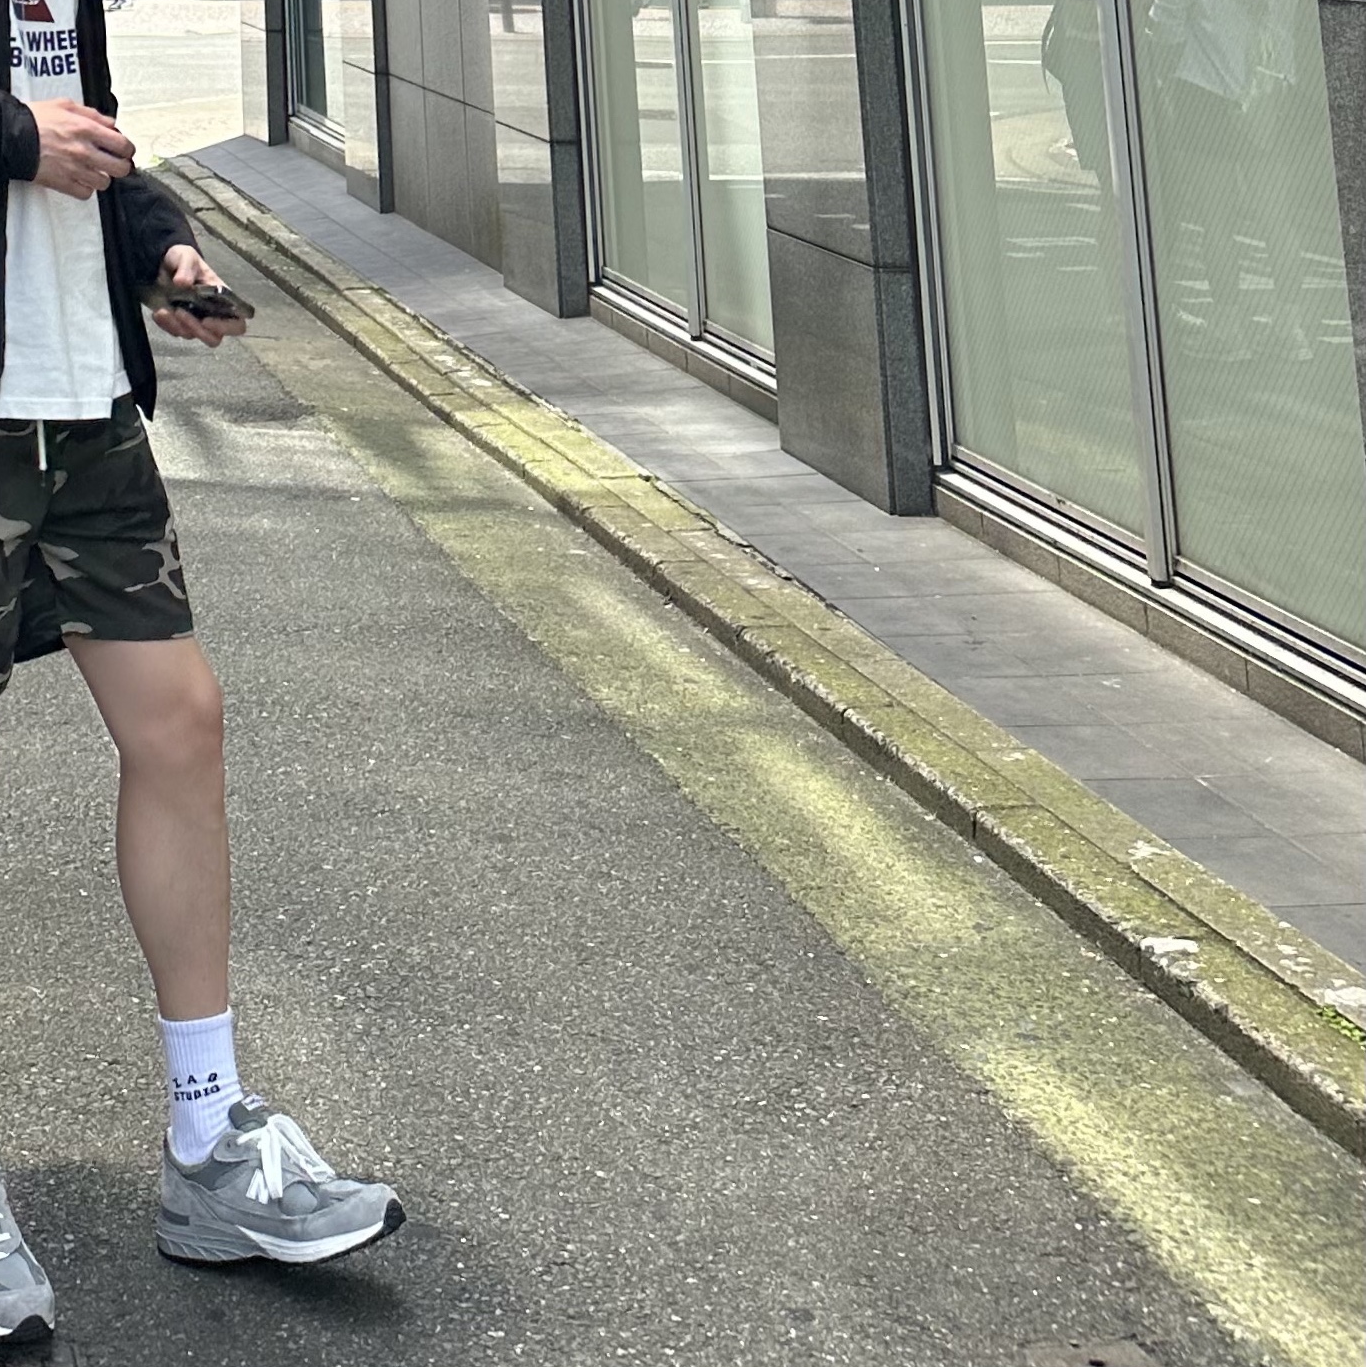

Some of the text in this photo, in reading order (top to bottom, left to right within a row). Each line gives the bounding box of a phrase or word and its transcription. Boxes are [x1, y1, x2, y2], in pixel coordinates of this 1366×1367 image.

[26, 29, 77, 52] WHEE
[25, 53, 78, 77] NAGE
[174, 1084, 221, 1101] STUDIO
